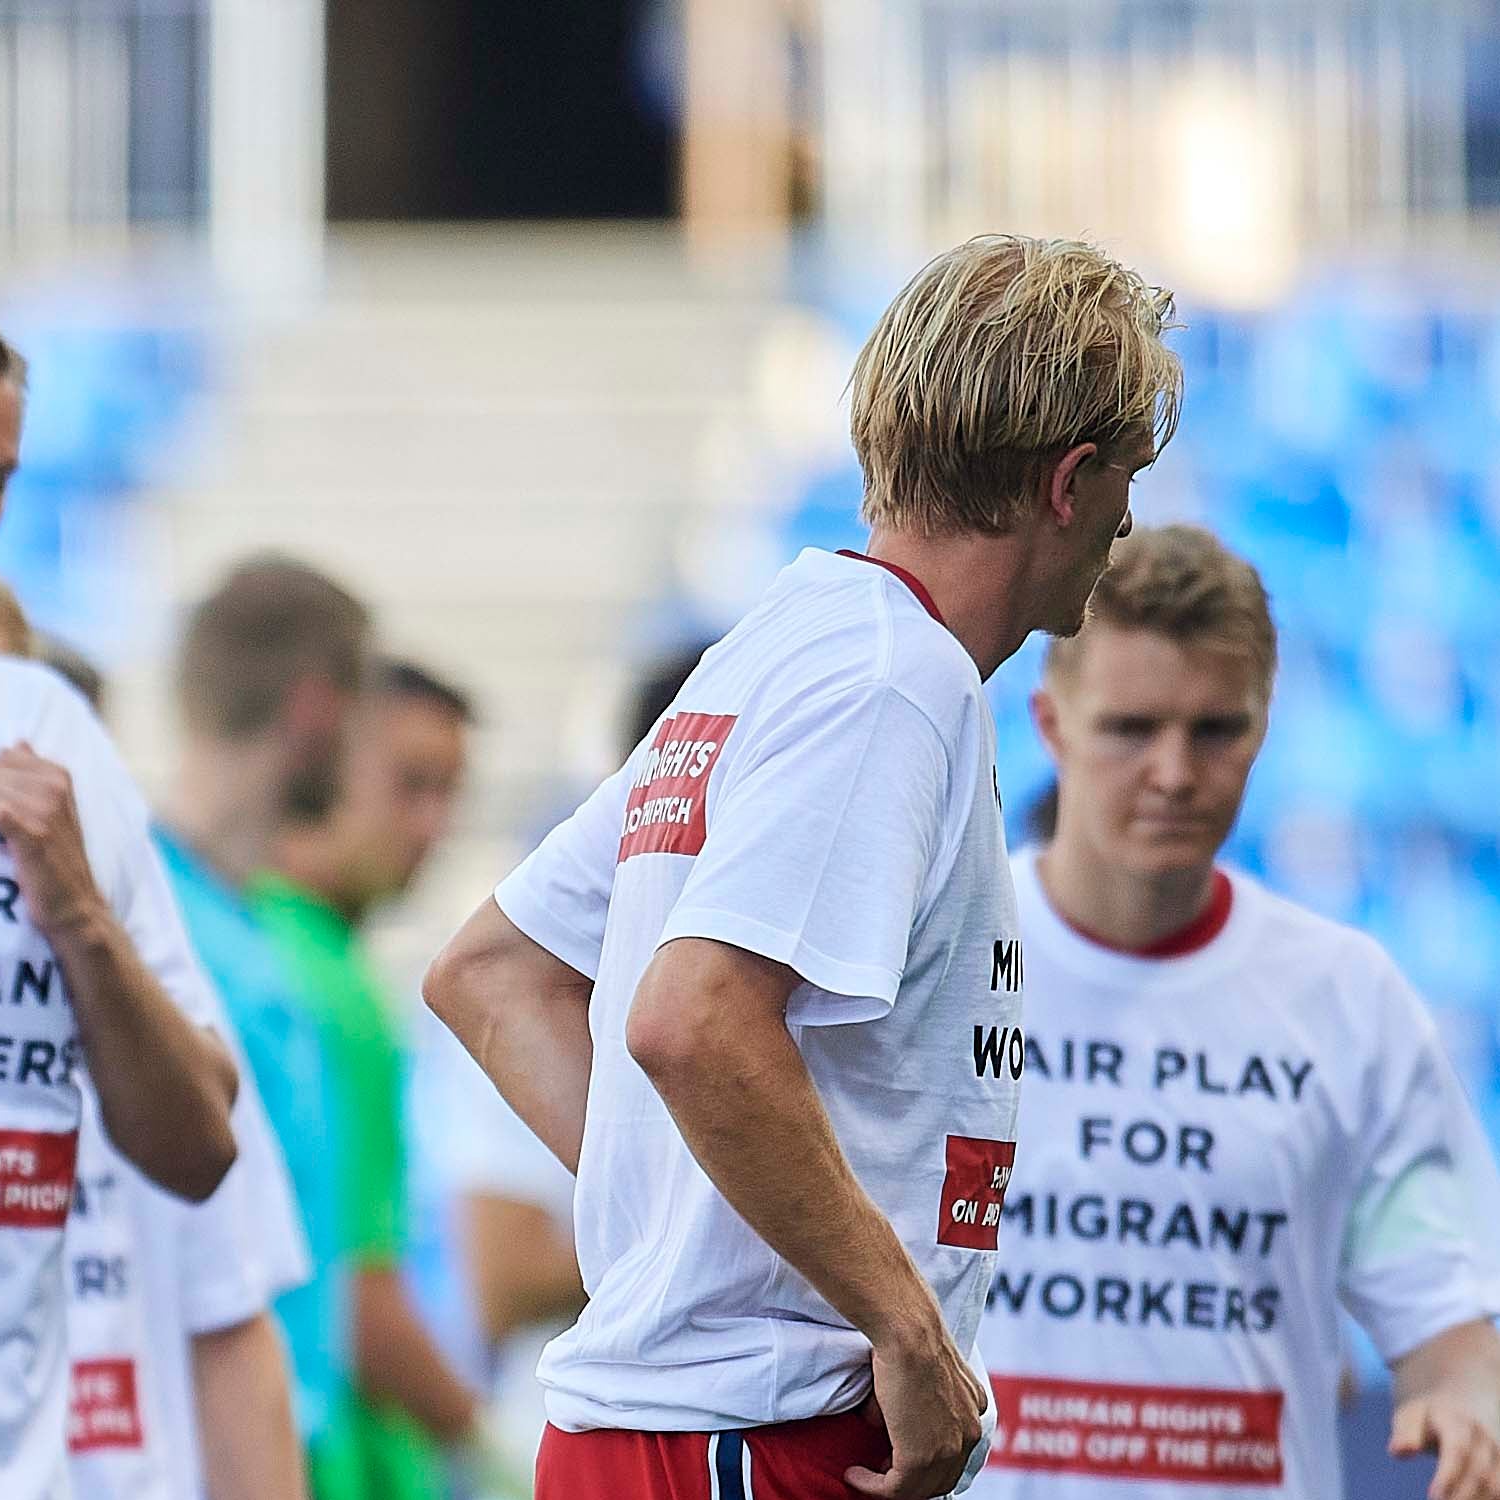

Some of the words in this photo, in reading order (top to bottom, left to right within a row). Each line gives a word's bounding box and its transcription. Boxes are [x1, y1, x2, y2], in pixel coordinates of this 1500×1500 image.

[1024, 1036, 1123, 1084] AIR
[1154, 1048, 1314, 1101] PLAY
[1080, 1118, 1215, 1171] FOR
[952, 1199, 976, 1225] ON
[1001, 1196, 1287, 1255] MIGRANT
[985, 1273, 1279, 1332] WORKERS
[1020, 1396, 1132, 1426] HUMAN
[1013, 1429, 1077, 1457] AND
